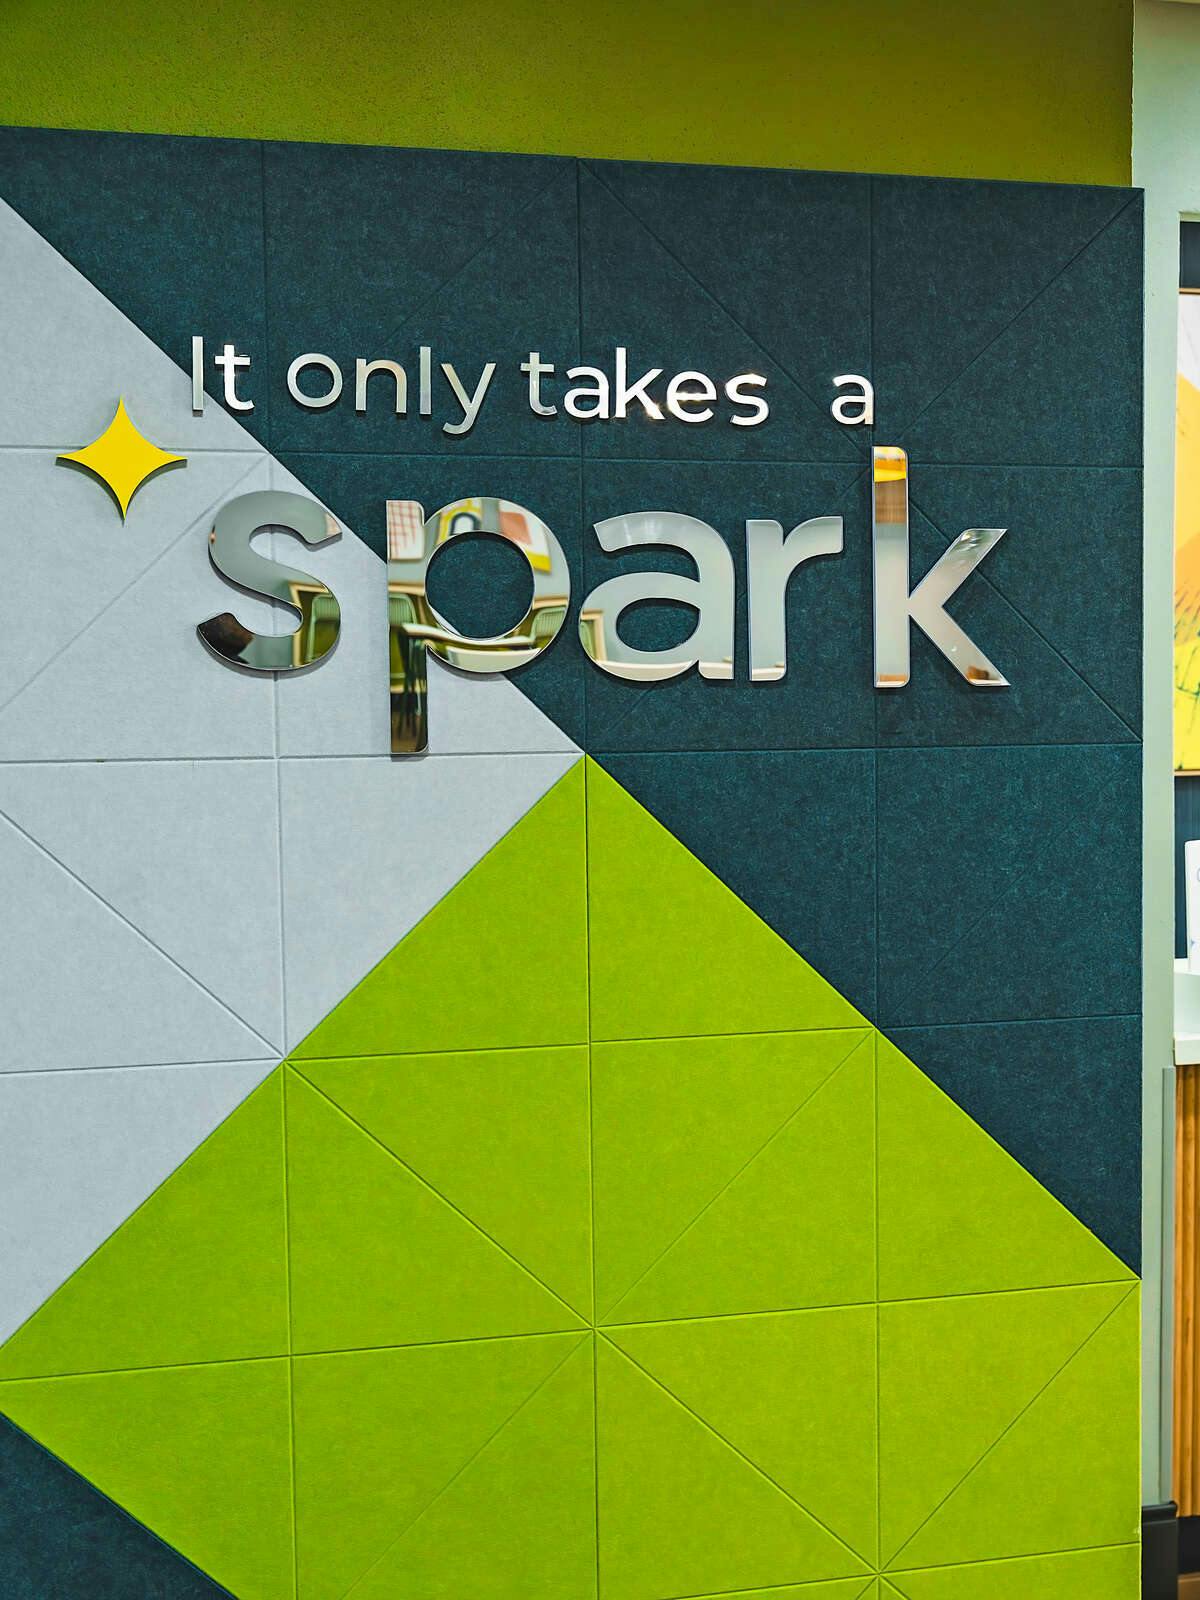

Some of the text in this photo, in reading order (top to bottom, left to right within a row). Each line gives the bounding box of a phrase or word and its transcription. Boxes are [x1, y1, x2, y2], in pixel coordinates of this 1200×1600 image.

[192, 335, 874, 434] It only takes a
[196, 446, 1011, 755] spark
